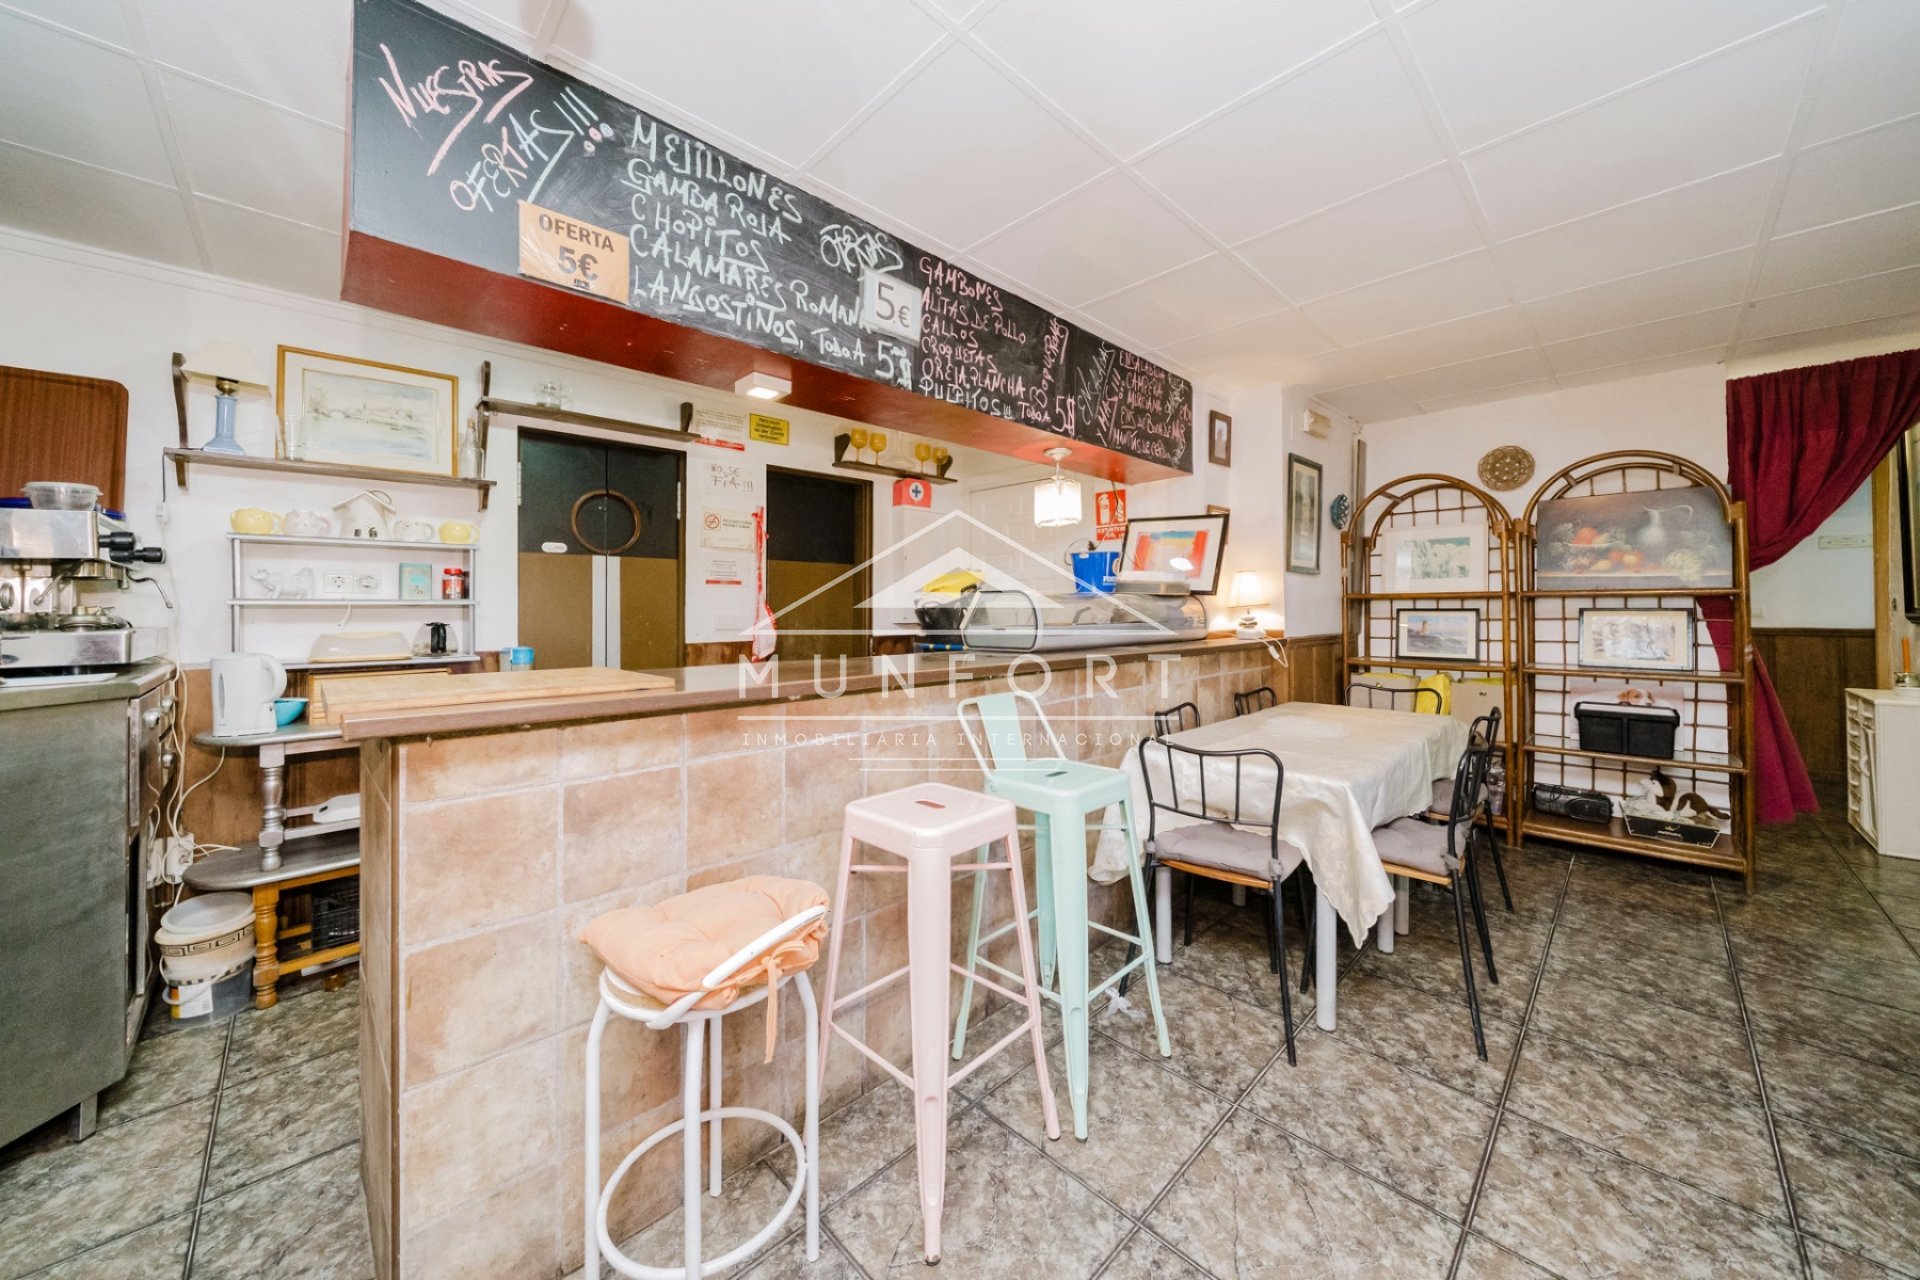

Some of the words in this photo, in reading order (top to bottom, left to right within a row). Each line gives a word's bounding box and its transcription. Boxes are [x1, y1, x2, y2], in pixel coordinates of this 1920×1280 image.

[538, 213, 615, 252] OFERTA
[557, 245, 599, 281] 5€
[920, 313, 979, 348] CALLOS
